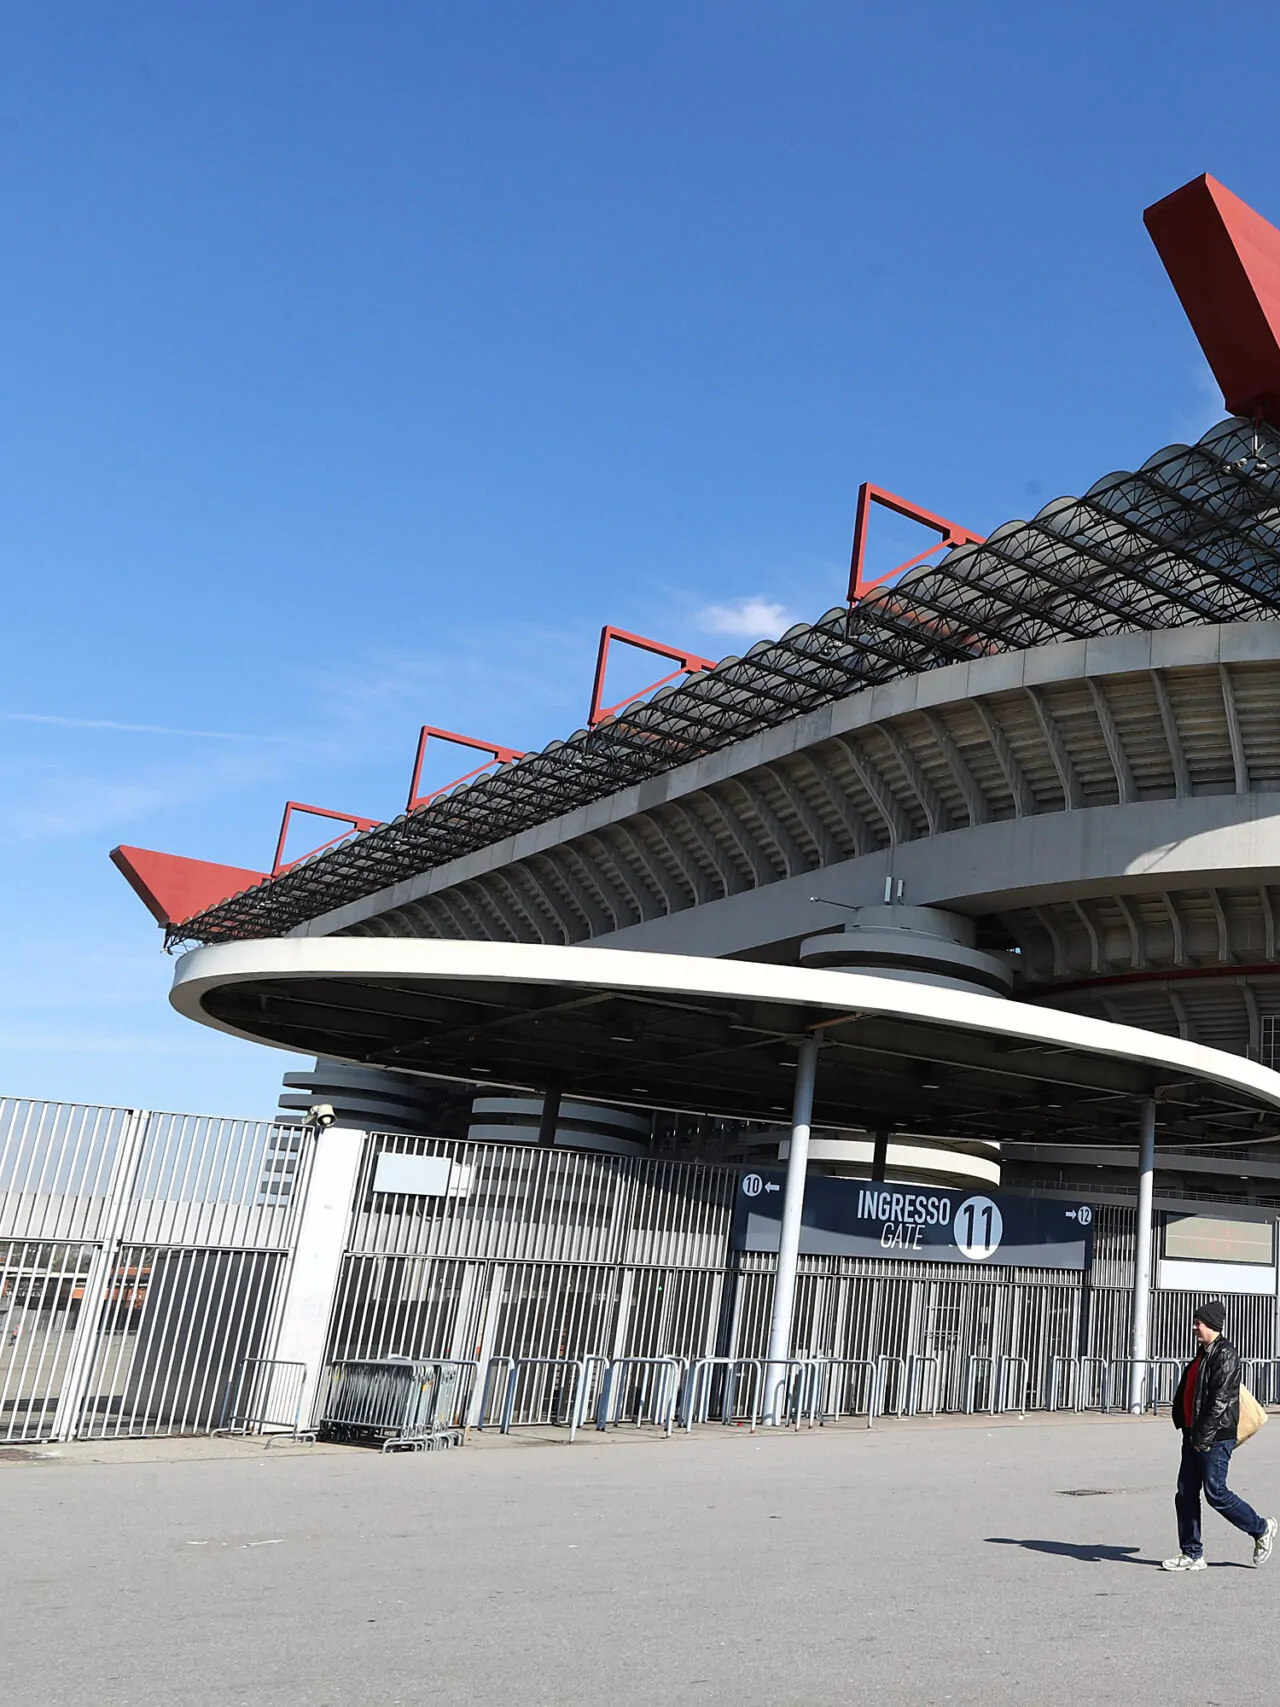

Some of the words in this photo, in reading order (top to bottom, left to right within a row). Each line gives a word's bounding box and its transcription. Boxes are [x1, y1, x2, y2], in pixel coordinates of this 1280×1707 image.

[746, 1176, 759, 1194] 10
[857, 1190, 951, 1225] INGRESSO
[1080, 1208, 1090, 1223] 12
[880, 1222, 925, 1250] GATE
[963, 1203, 993, 1252] 11
